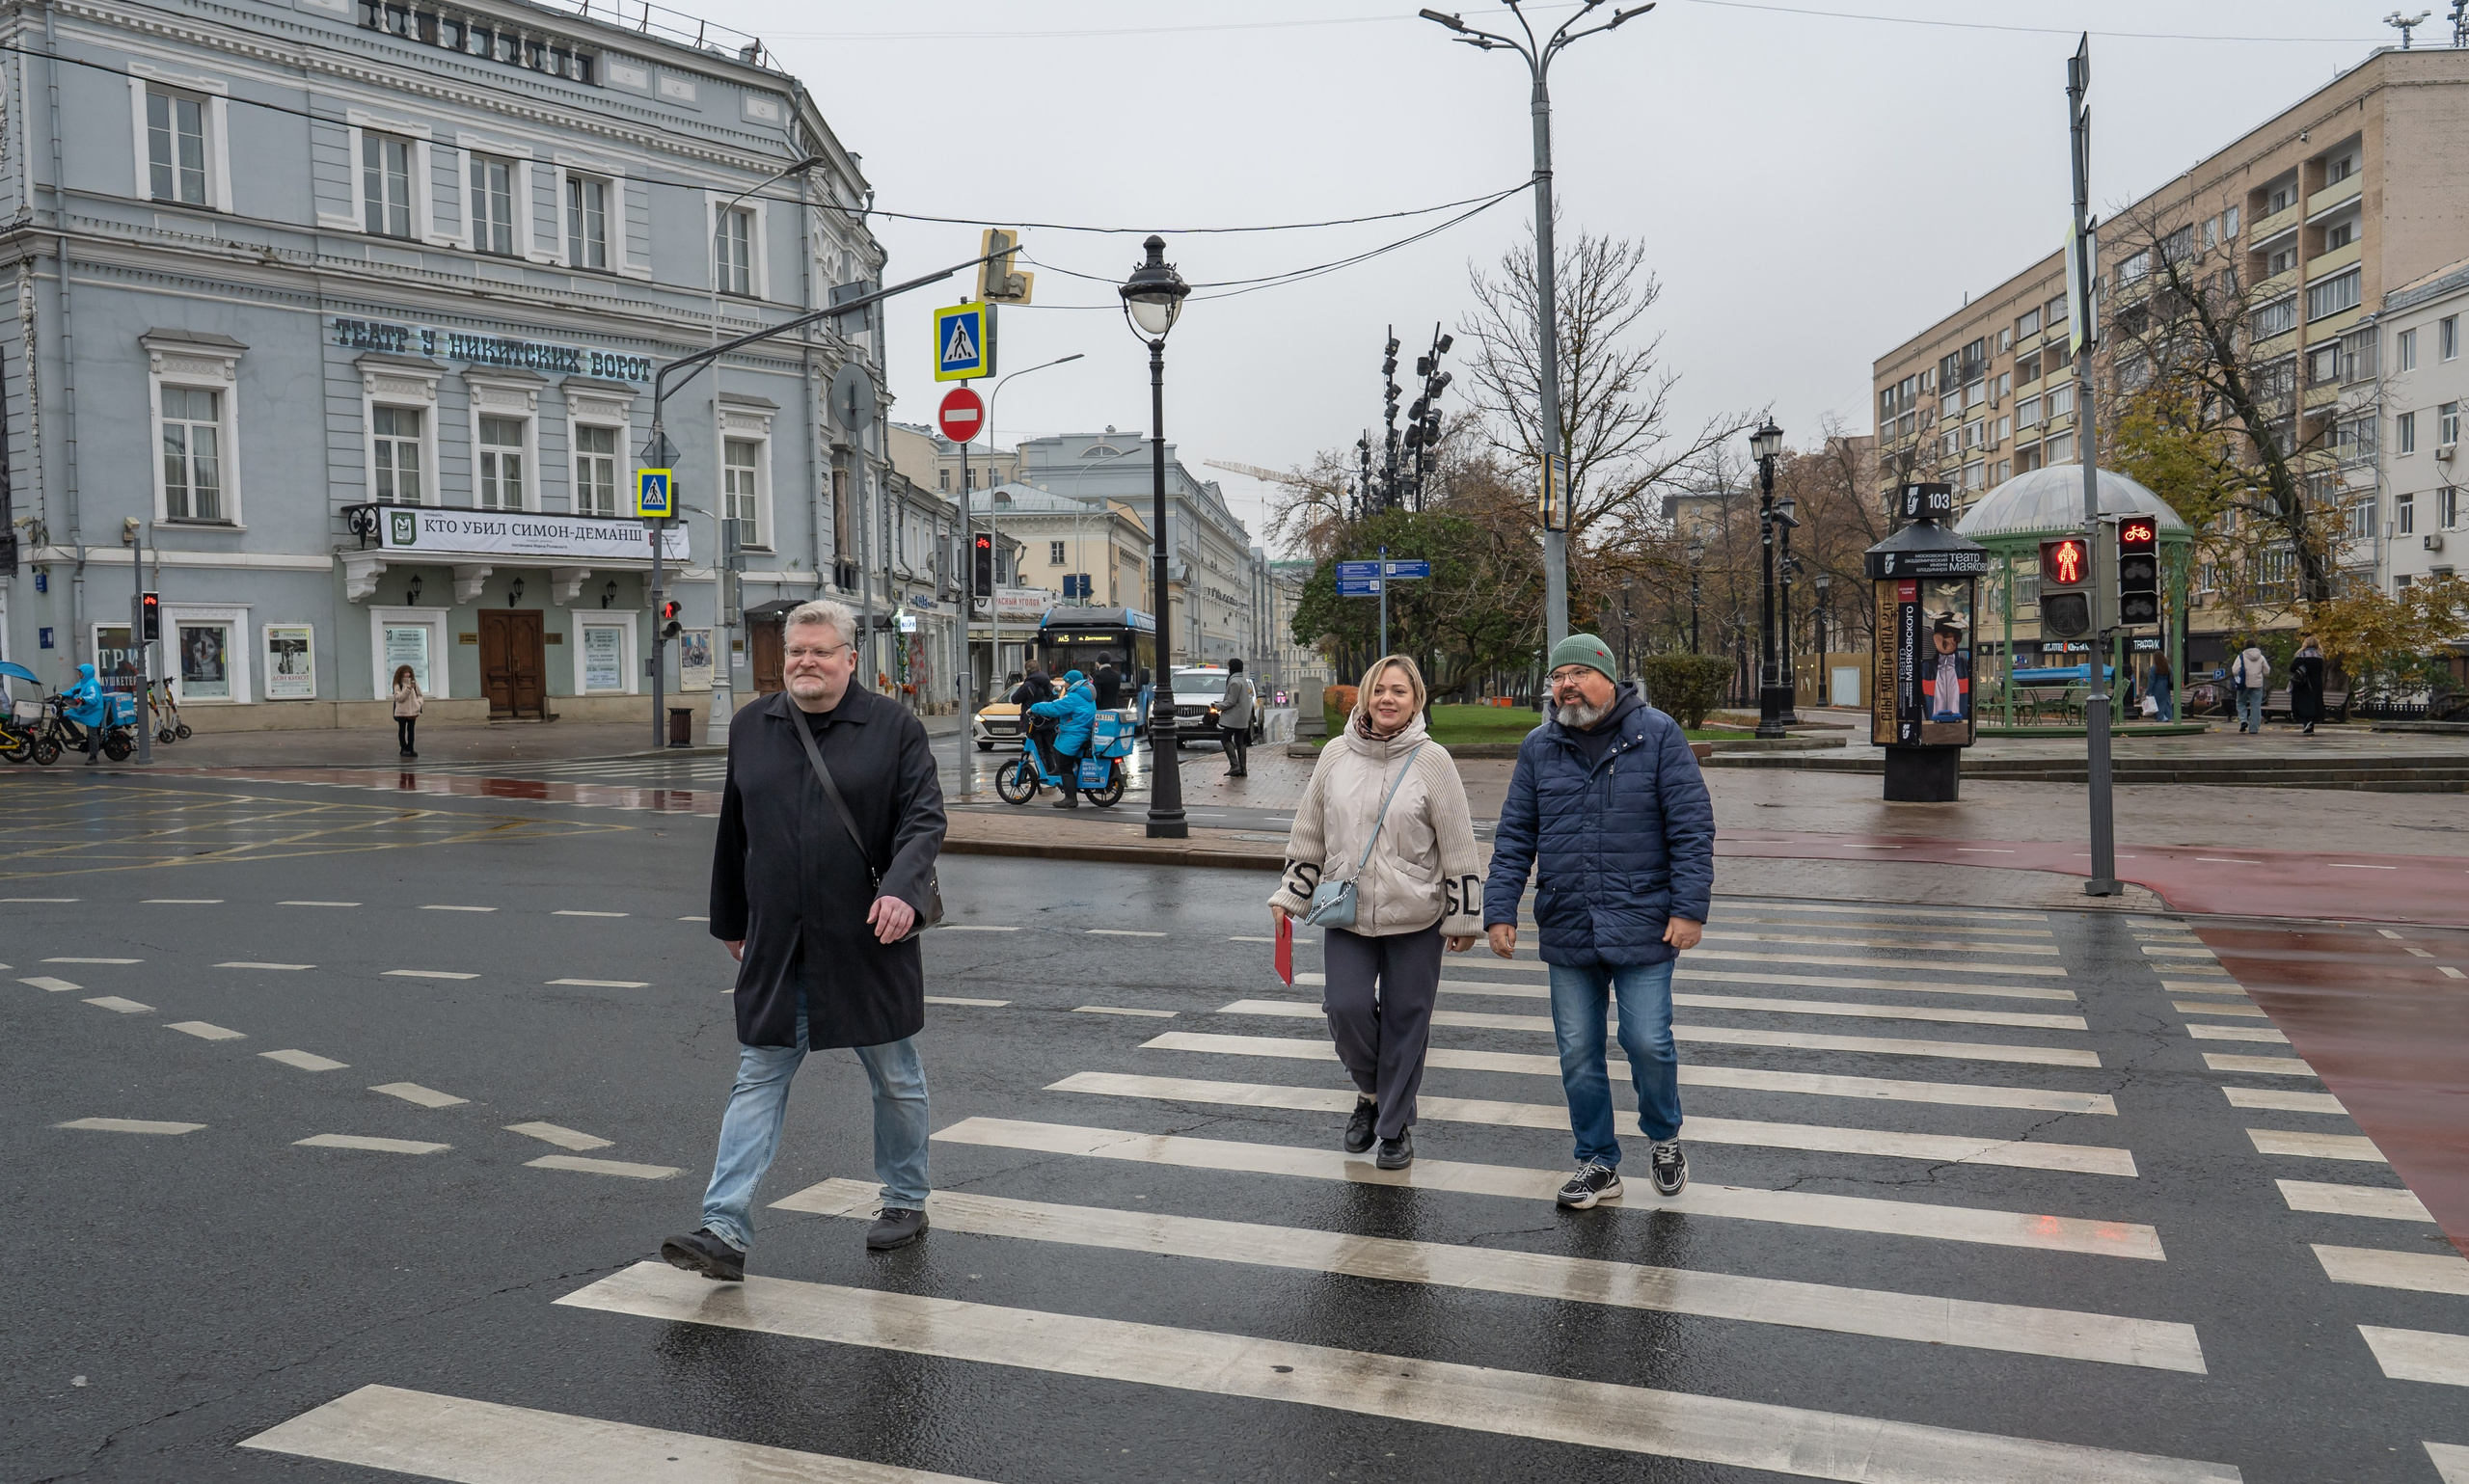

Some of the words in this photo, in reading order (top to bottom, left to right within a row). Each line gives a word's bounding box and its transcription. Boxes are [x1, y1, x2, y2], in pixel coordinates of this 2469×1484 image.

[336, 318, 409, 353] ТЕАТР
[421, 329, 436, 356] У
[448, 333, 582, 374] НИКИТСКИХ
[590, 351, 651, 382] ВОРОТ
[1928, 493, 1950, 509] 103
[424, 519, 457, 533] КТО
[462, 521, 507, 535] УБИЛ
[511, 524, 642, 541] СИМОН-ДЕМАНШ
[1018, 598, 1040, 607] УГОЛОК
[1883, 603, 1894, 621] 2.0
[1882, 628, 1894, 653] ОТЦА
[98, 648, 139, 669] ТРИ
[1882, 658, 1893, 692] МОЕГО
[1882, 699, 1893, 721] СНЫ
